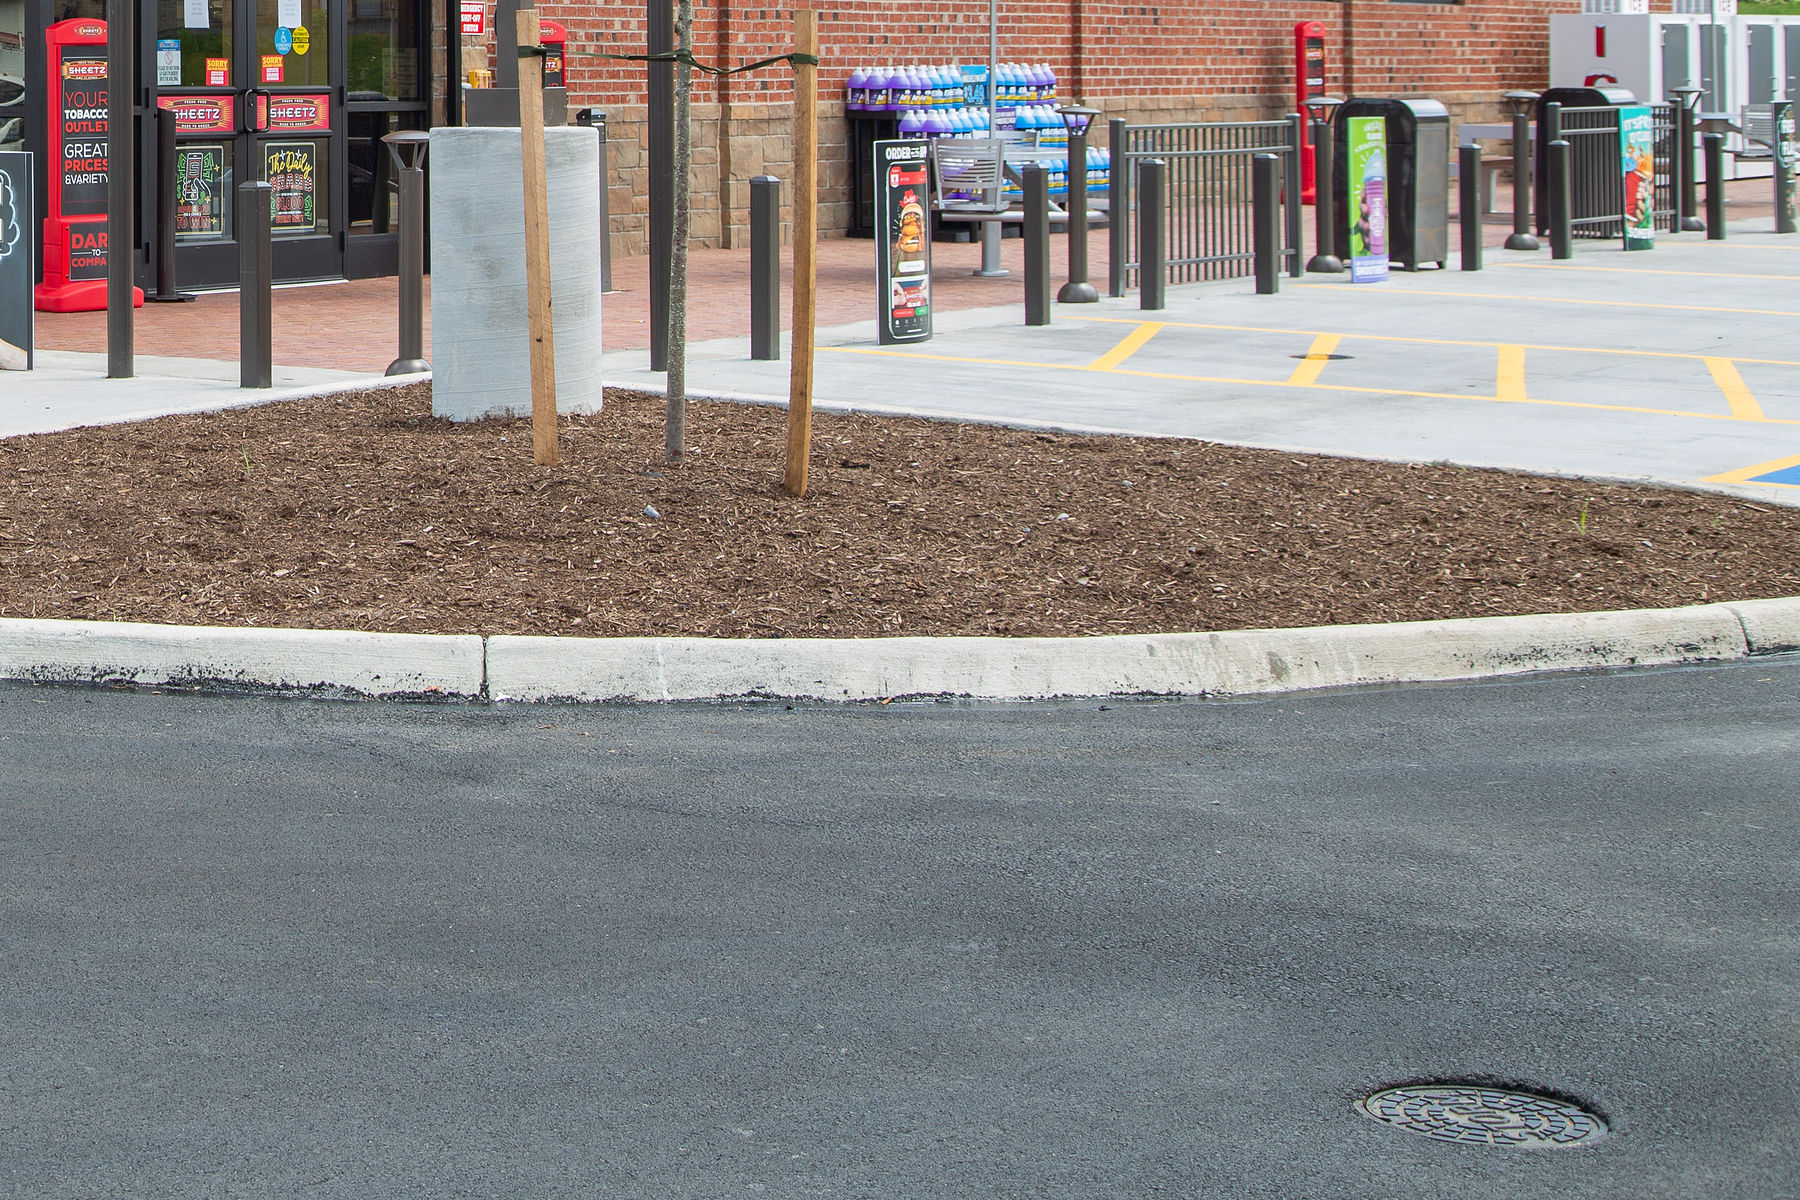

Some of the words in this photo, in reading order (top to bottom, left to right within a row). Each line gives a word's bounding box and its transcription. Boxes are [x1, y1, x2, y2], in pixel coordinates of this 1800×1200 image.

[461, 4, 484, 13] MERGENCY
[1630, 0, 1643, 13] ICE
[262, 57, 282, 65] SORRY
[68, 66, 106, 74] SHEETZ
[65, 91, 108, 108] YOUR
[174, 108, 220, 119] SHEETZ
[270, 107, 316, 118] SHEETZ
[65, 121, 108, 133] OUTLET
[64, 143, 108, 159] GREAT
[885, 146, 911, 160] ORDER
[64, 159, 108, 172] PRICES
[268, 152, 285, 175] The
[286, 150, 313, 179] Daily
[65, 173, 108, 185] &VARIETY
[176, 216, 187, 229] TO
[190, 216, 210, 229] WIN
[71, 232, 108, 249] DAR
[91, 248, 101, 256] TO
[71, 256, 108, 267] COMPA
